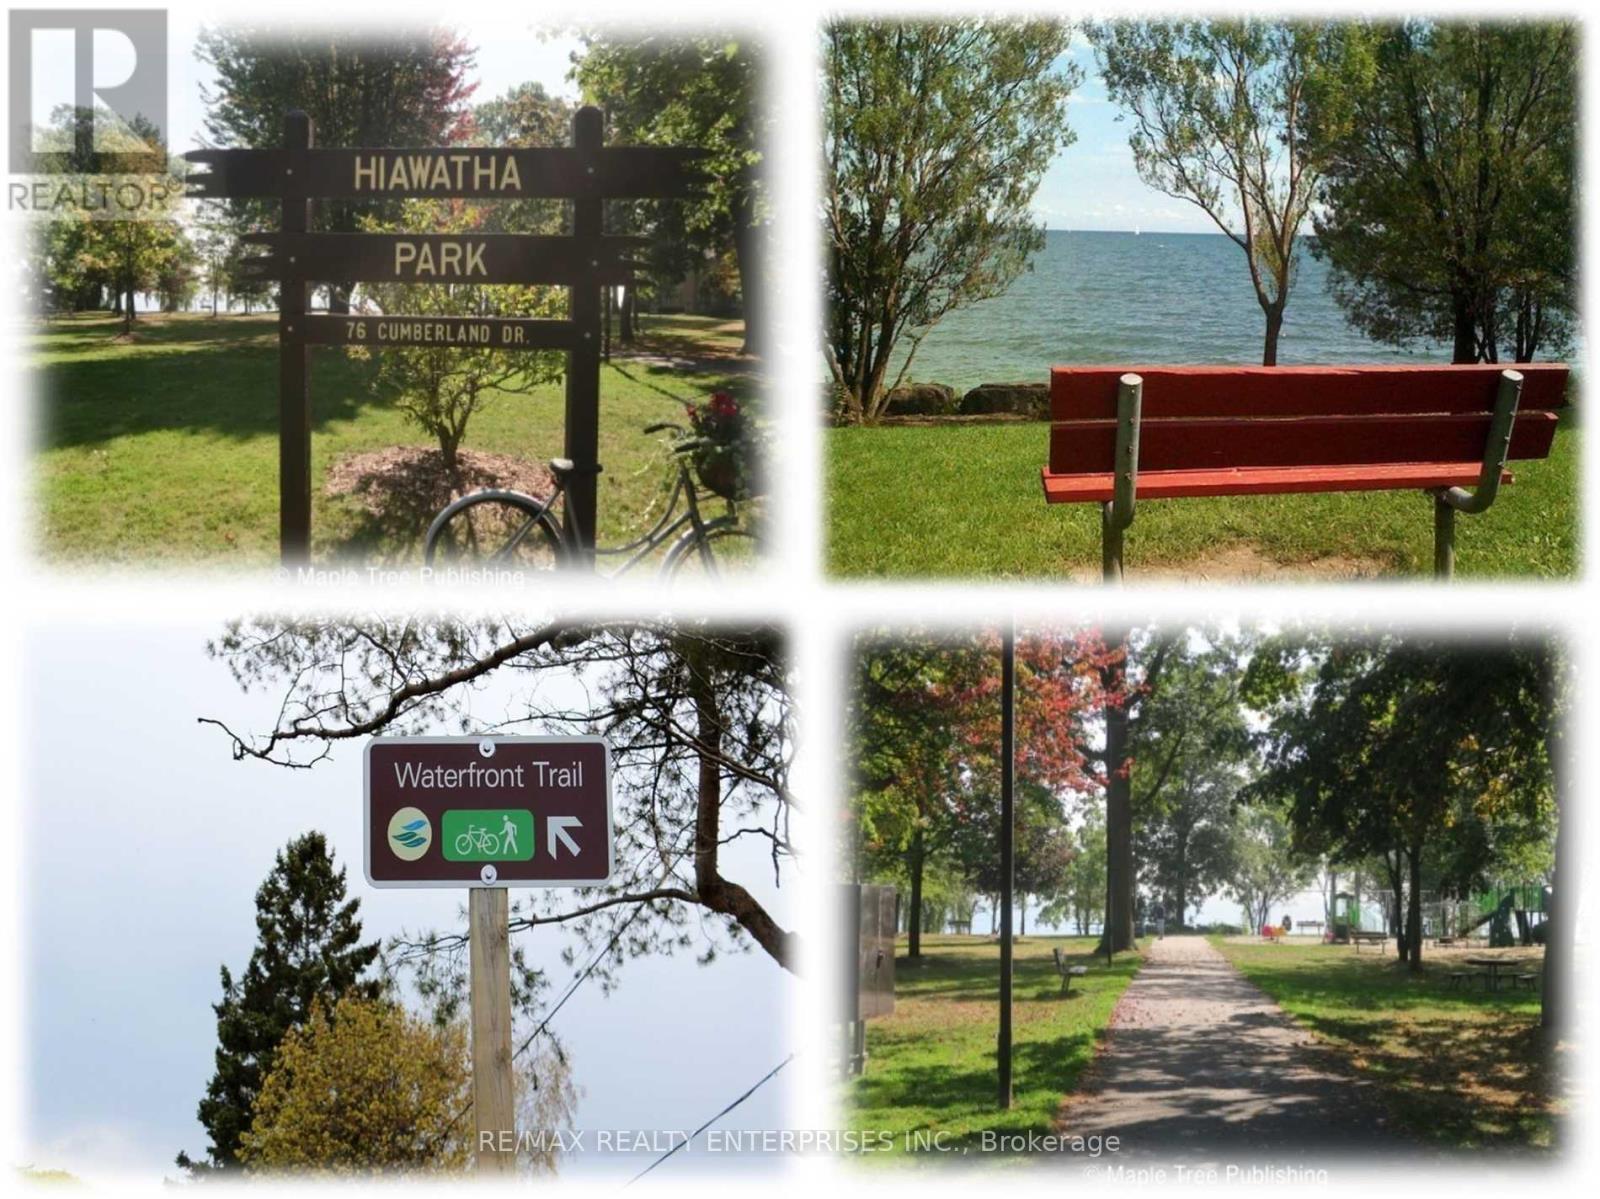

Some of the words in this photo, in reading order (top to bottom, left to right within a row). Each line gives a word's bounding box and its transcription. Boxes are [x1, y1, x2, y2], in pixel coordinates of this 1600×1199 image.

[353, 155, 522, 192] HIAWATHA
[394, 242, 488, 277] PARK
[346, 321, 367, 341] 76
[377, 322, 492, 343] CUMBERLAND
[502, 326, 530, 345] DR.
[394, 761, 525, 788] Waterfront
[532, 761, 583, 787] Trail
